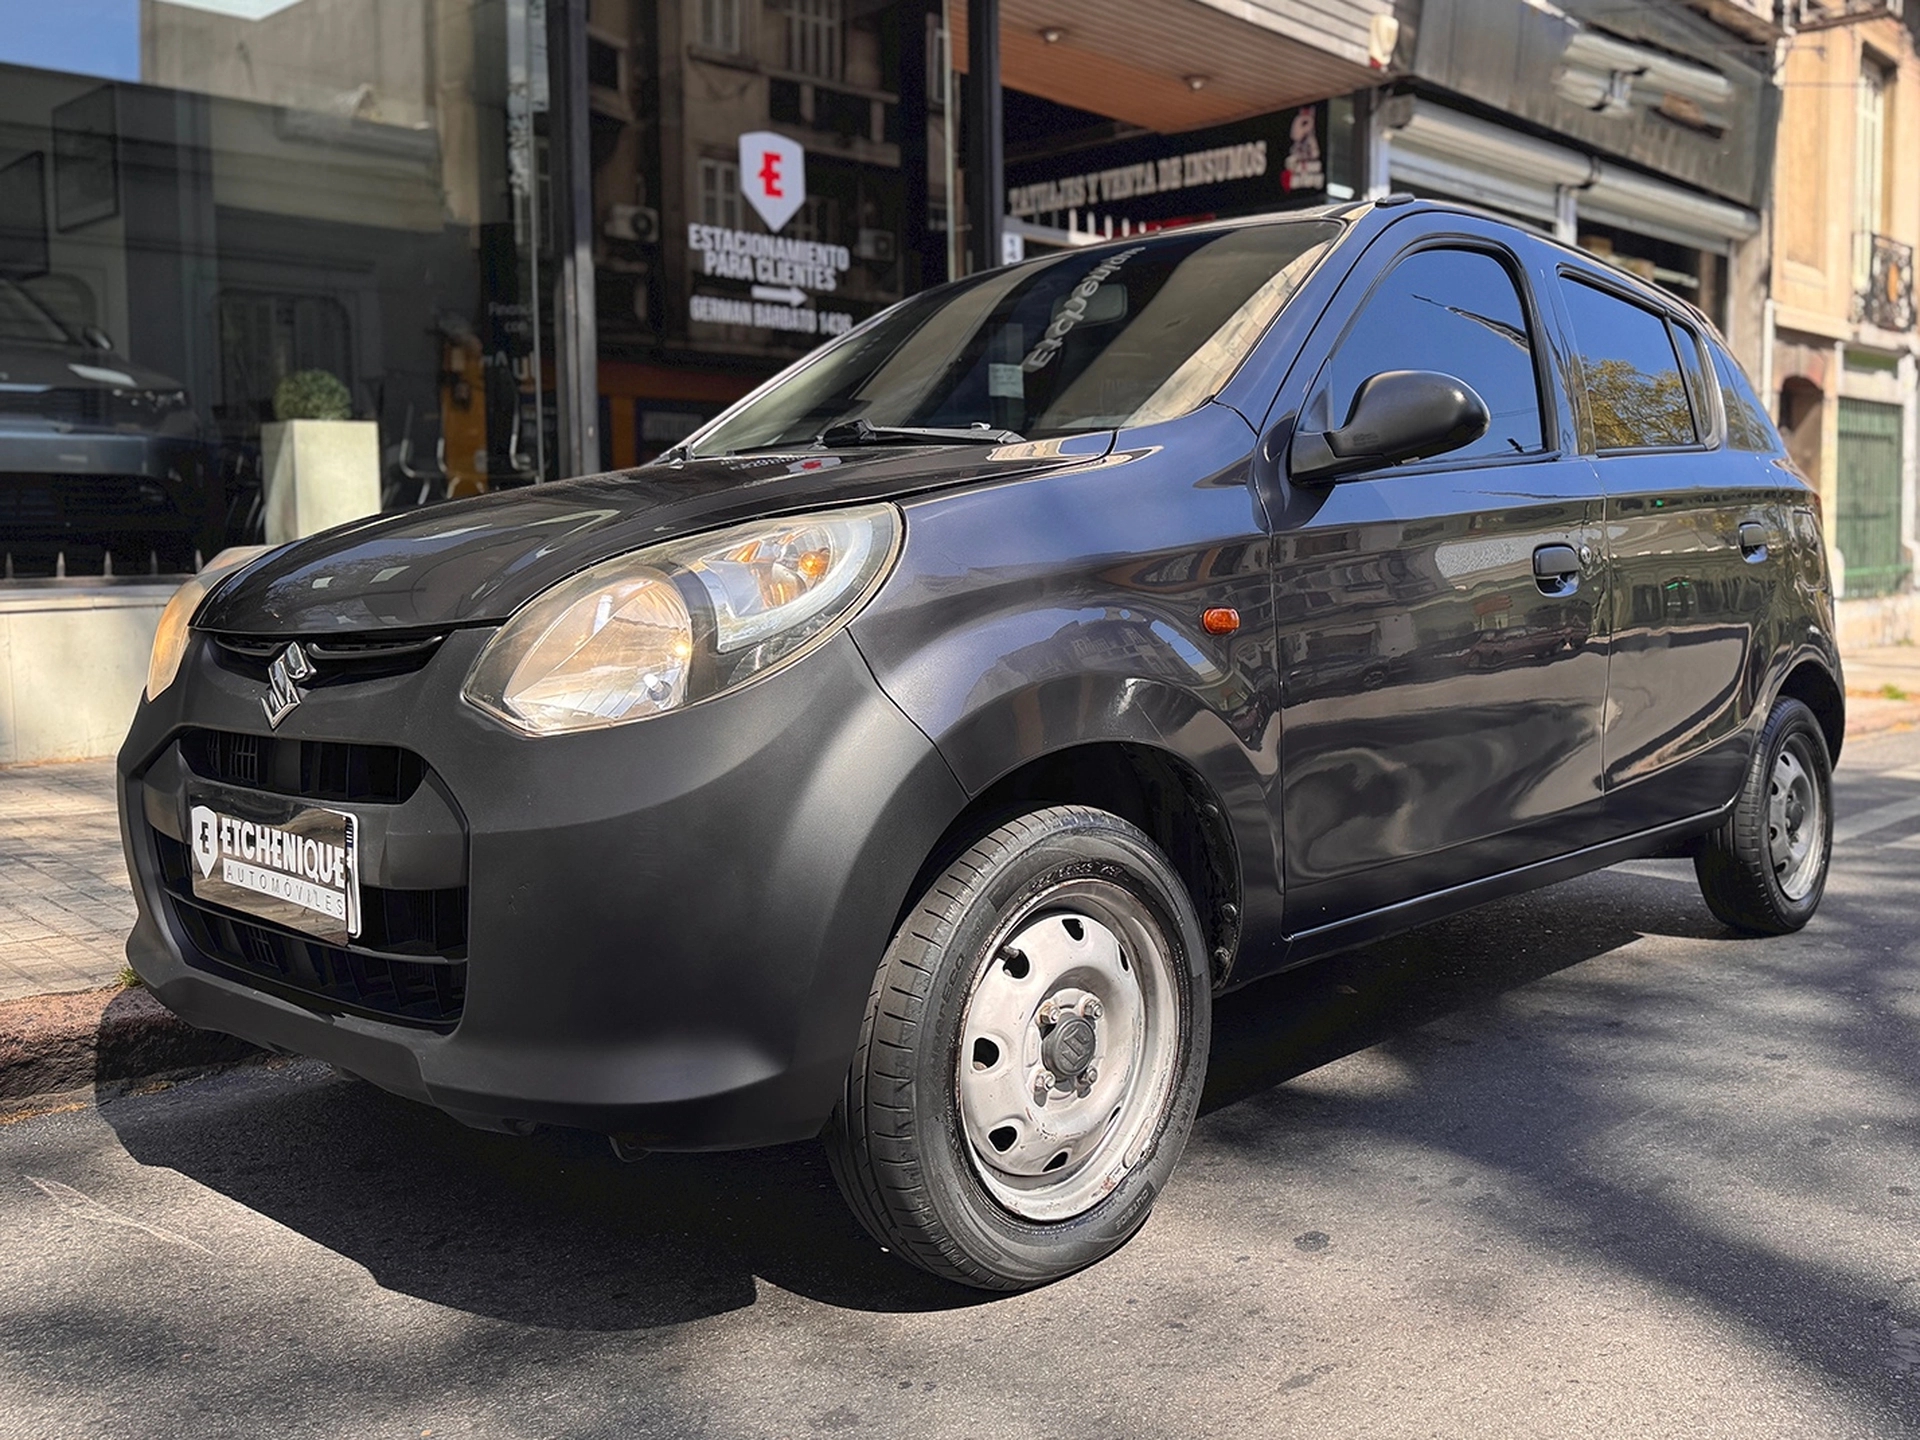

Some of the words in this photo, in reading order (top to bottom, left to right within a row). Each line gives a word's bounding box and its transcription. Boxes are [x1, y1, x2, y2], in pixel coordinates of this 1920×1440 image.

[688, 222, 850, 272] ESTACIONAMIENTO
[704, 248, 754, 281] PARA
[756, 259, 836, 292] CLIENTES
[219, 816, 346, 890] ETCHENIQUE
[225, 863, 345, 916] AUTOMÓVILES
